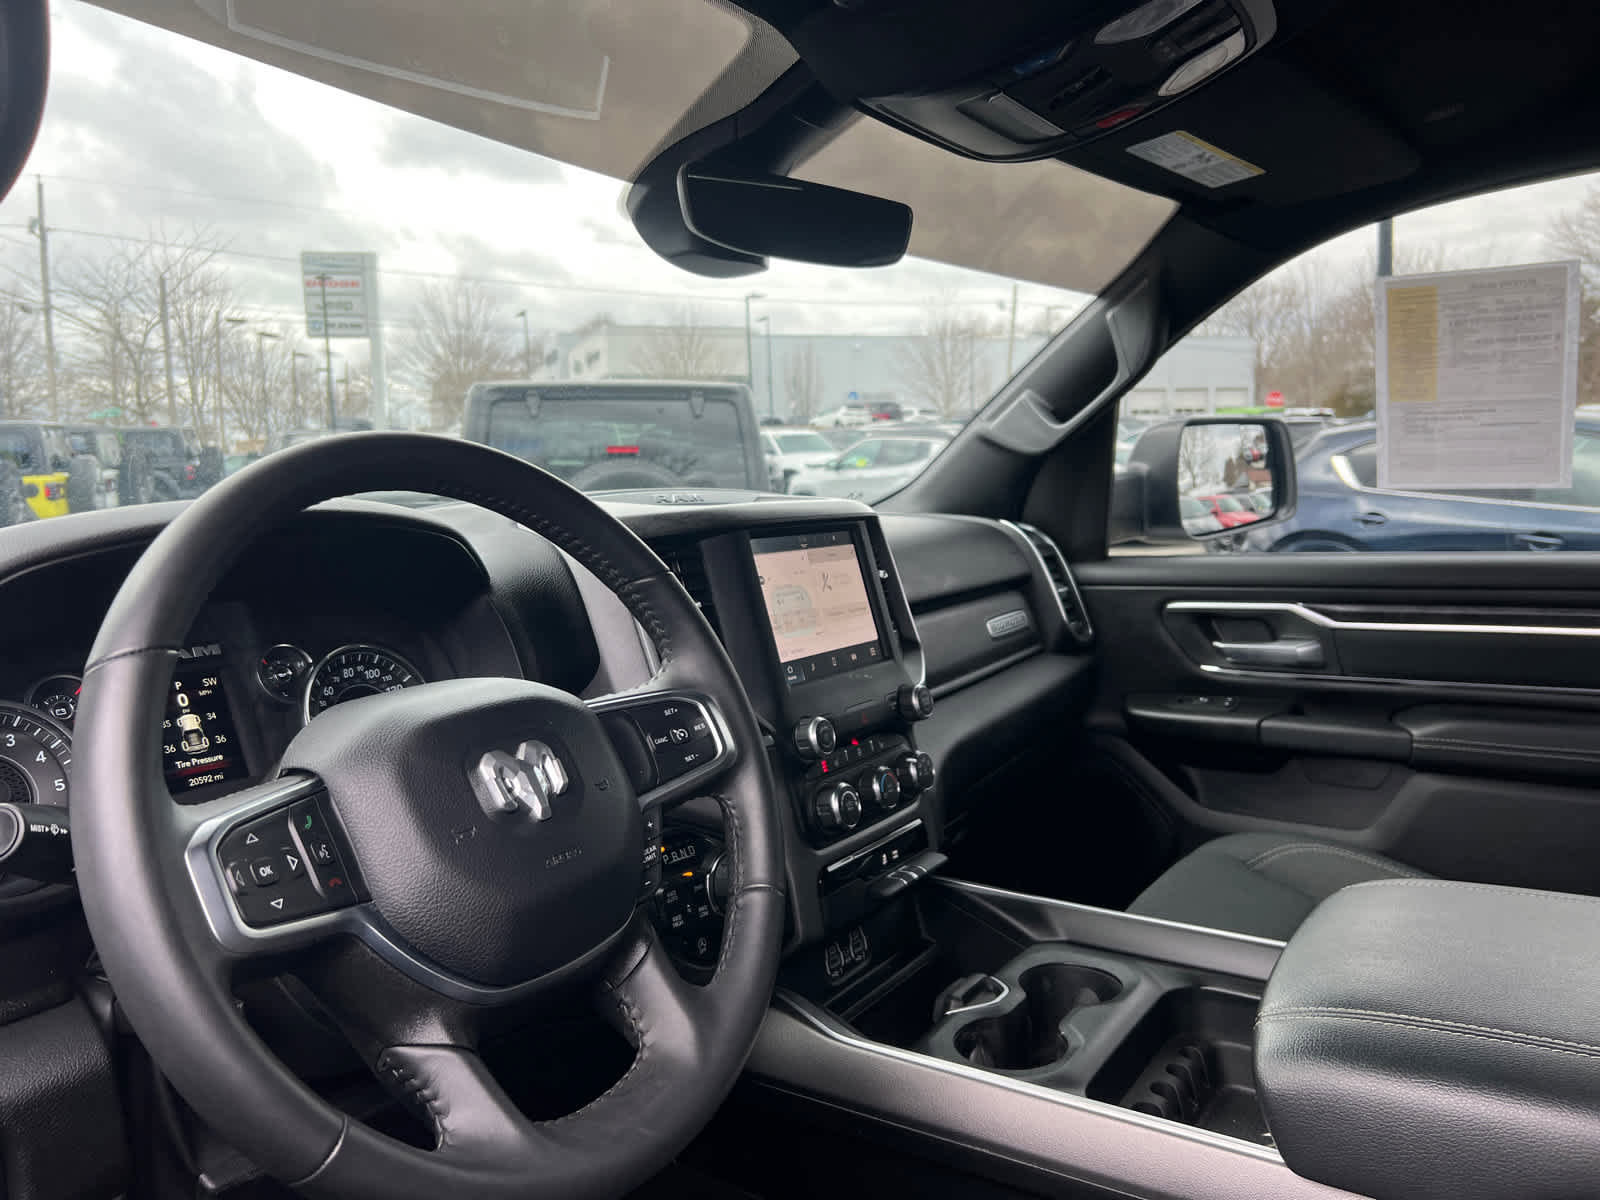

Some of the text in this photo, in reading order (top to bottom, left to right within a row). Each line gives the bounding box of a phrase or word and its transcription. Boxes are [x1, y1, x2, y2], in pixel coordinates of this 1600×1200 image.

[343, 668, 354, 679] 80
[364, 668, 381, 679] 100
[202, 677, 217, 687] SW
[323, 686, 334, 696] 60
[206, 712, 217, 721] 34
[5, 734, 16, 747] 3
[215, 735, 227, 744] 36
[163, 744, 177, 754] 36
[35, 750, 47, 763] 4
[175, 754, 224, 769] Tire Pressure
[54, 779, 66, 791] 5
[188, 772, 224, 787] 20592 mi
[259, 864, 274, 877] OK
